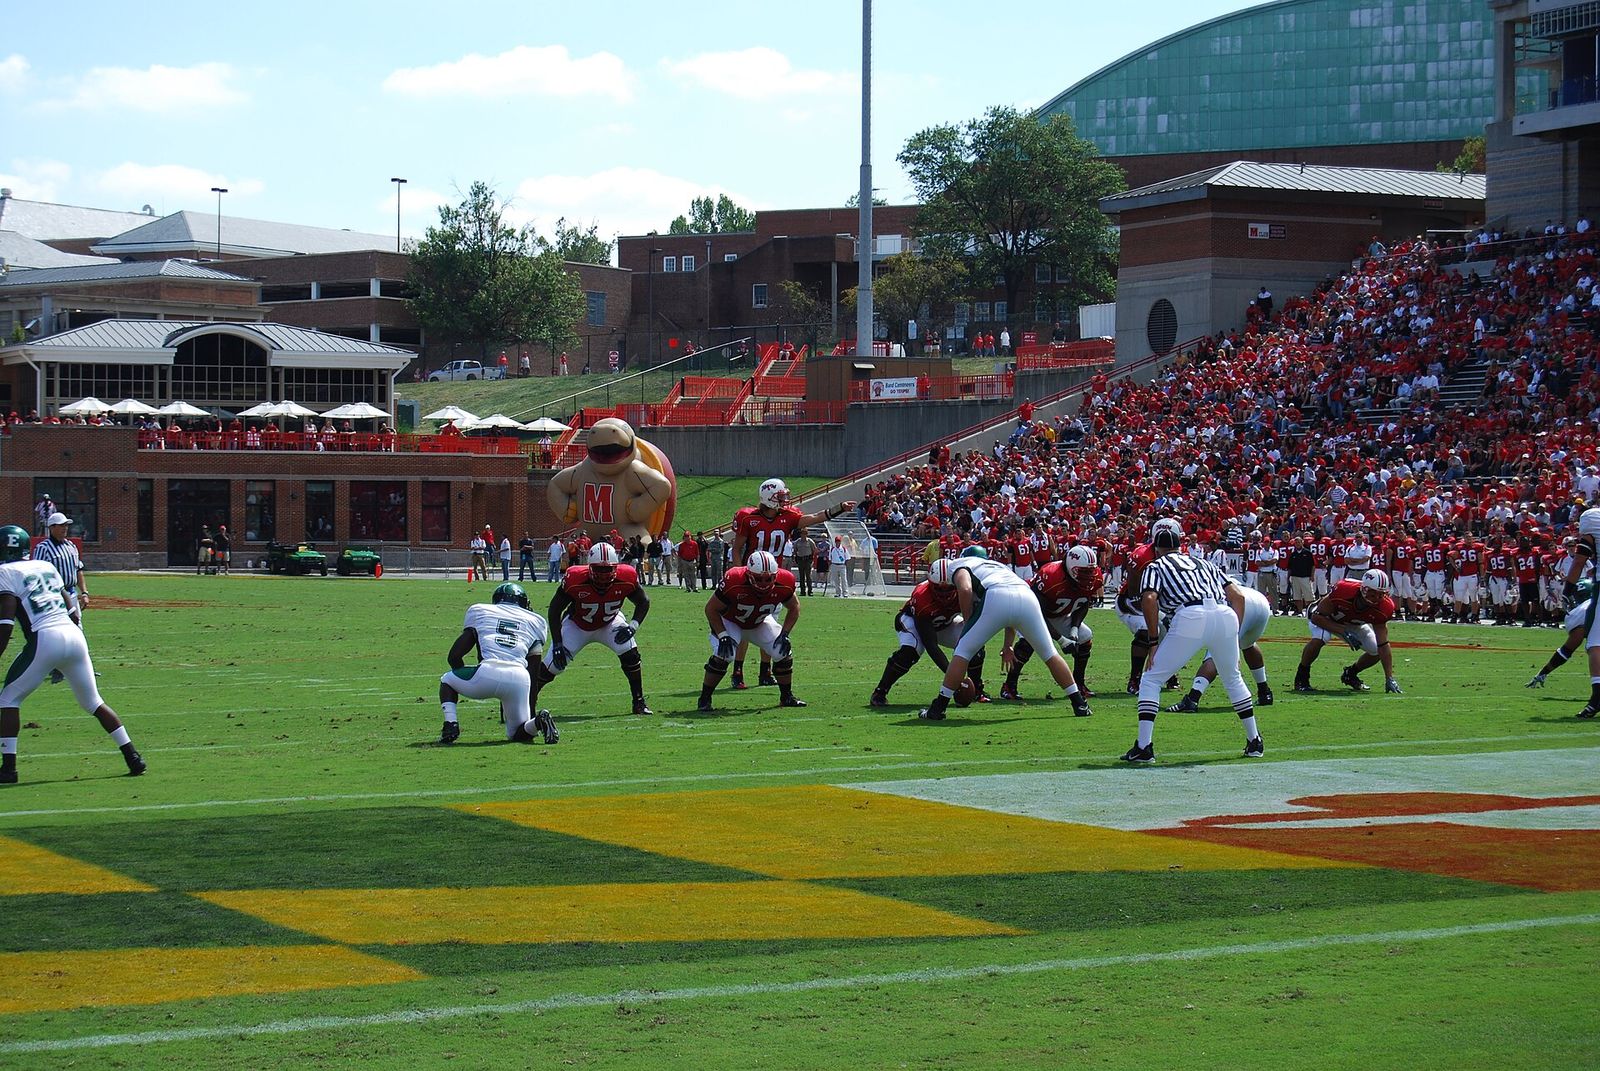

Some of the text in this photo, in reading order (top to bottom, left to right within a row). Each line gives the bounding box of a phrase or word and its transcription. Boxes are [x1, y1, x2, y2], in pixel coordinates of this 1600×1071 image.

[1250, 228, 1258, 237] M
[583, 482, 614, 524] M
[7, 533, 20, 548] E
[756, 529, 786, 557] 10
[944, 548, 958, 560] 32
[1017, 544, 1030, 556] 61
[1279, 546, 1296, 559] 57
[1310, 544, 1326, 556] 68
[1331, 543, 1346, 558] 73
[1427, 550, 1442, 563] 66
[1460, 549, 1477, 562] 36
[1229, 559, 1238, 571] M
[1491, 556, 1506, 570] 85
[1519, 556, 1535, 571] 24
[580, 600, 622, 624] 75
[734, 603, 777, 624] 72
[495, 618, 521, 649] 5
